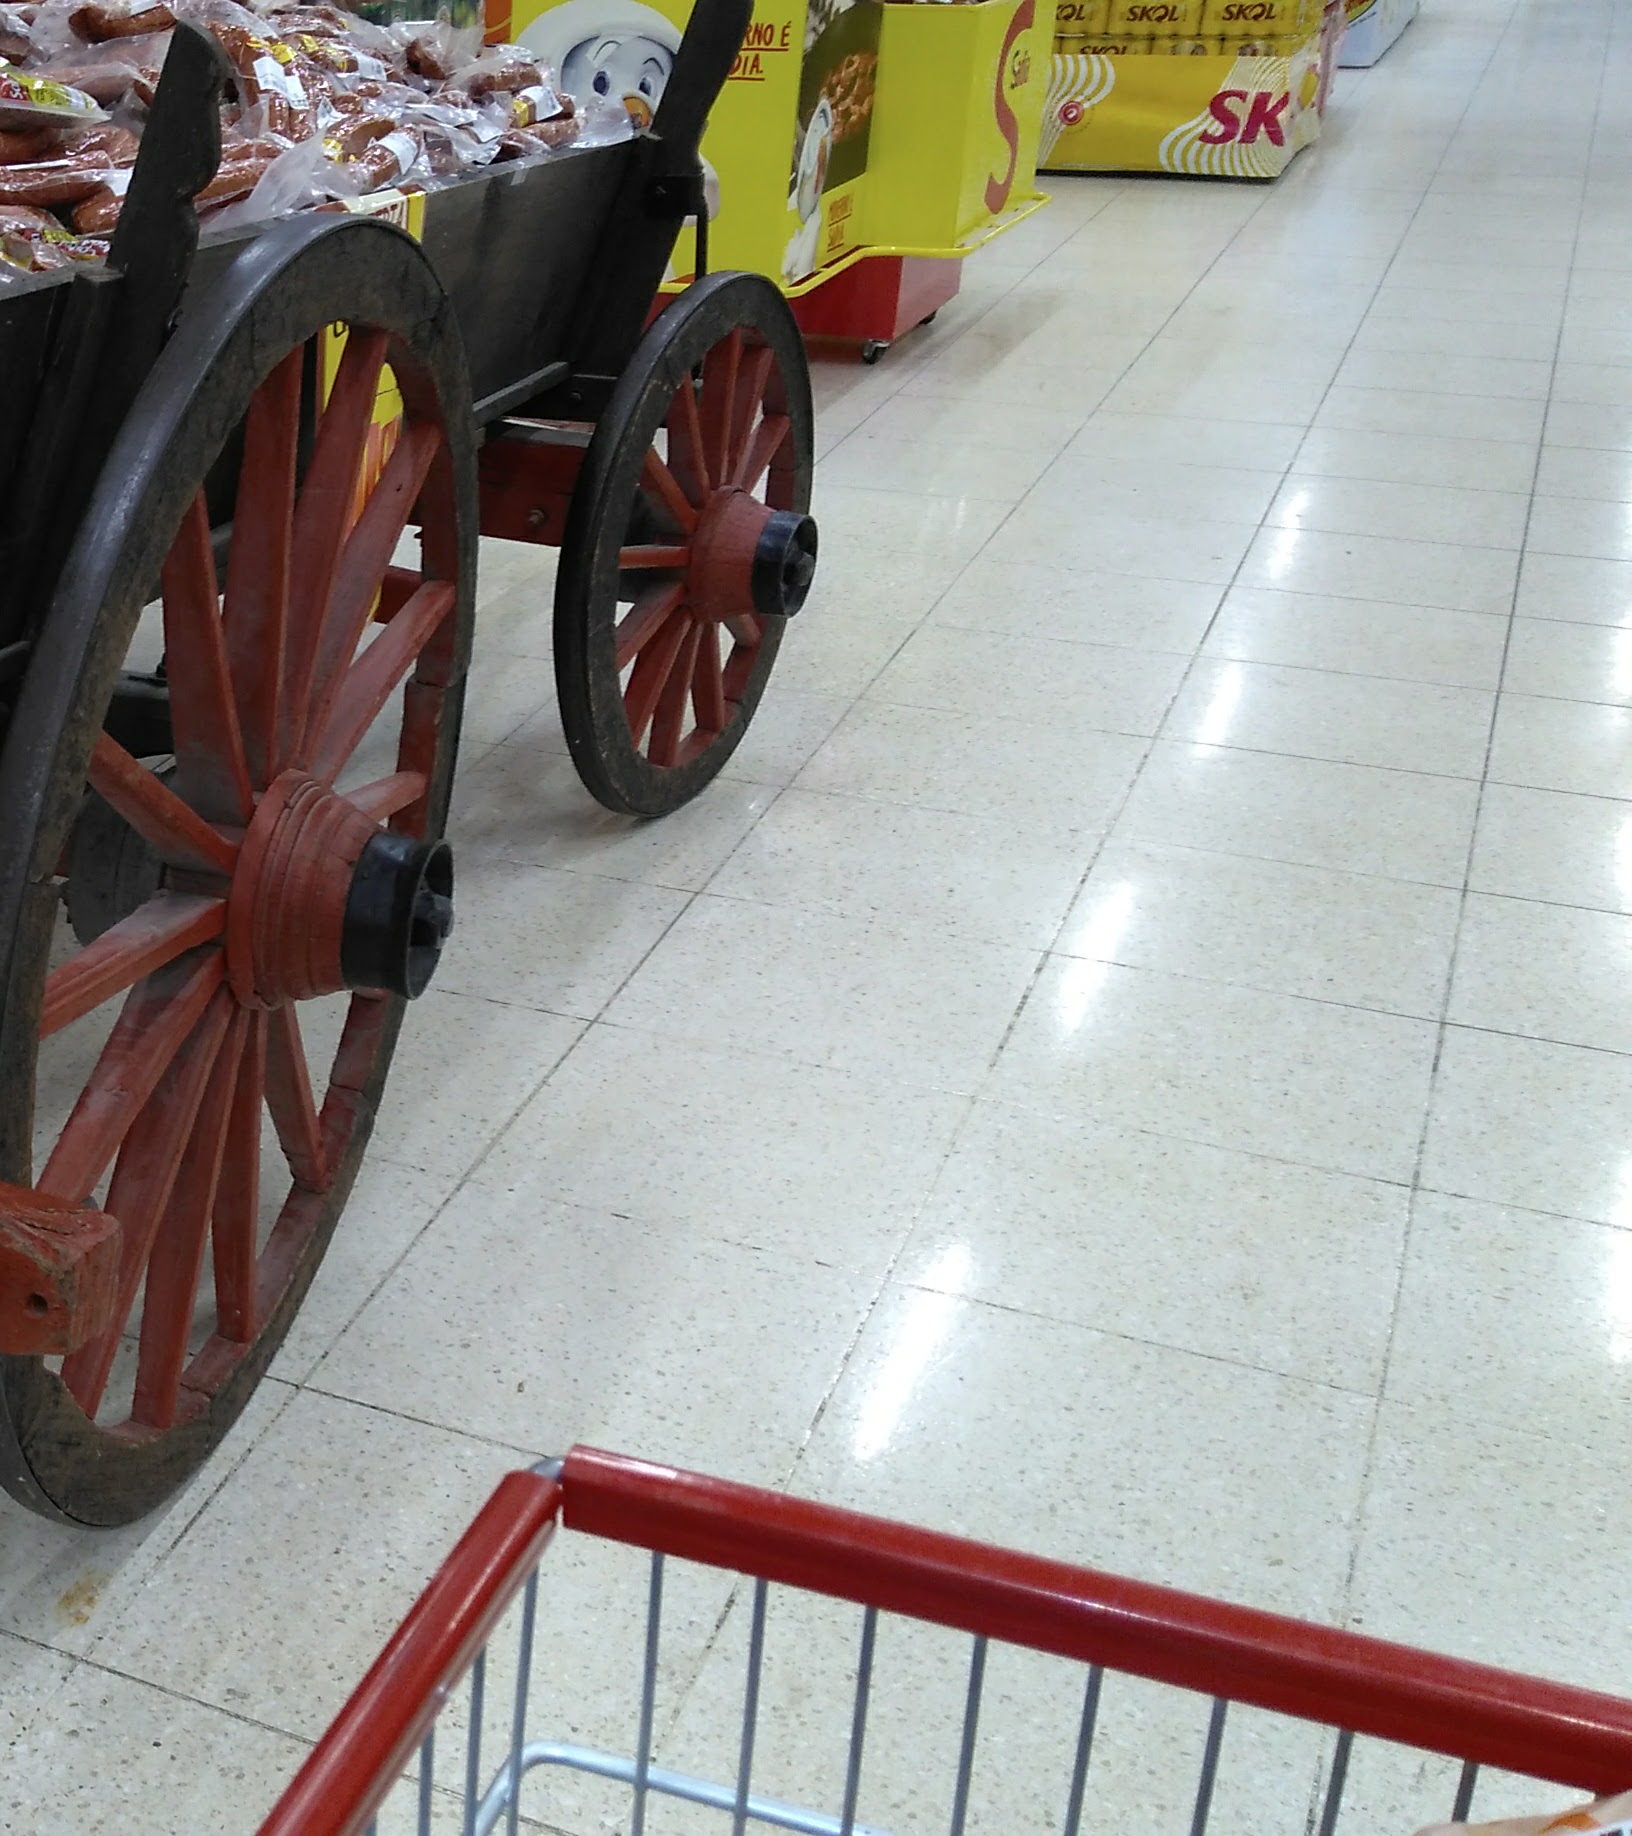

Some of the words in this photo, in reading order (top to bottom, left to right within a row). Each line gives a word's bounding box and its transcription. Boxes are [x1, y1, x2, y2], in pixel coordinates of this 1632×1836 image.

[1126, 5, 1180, 22] SKOL
[1222, 4, 1277, 21] SKOL
[1198, 89, 1290, 147] SK
